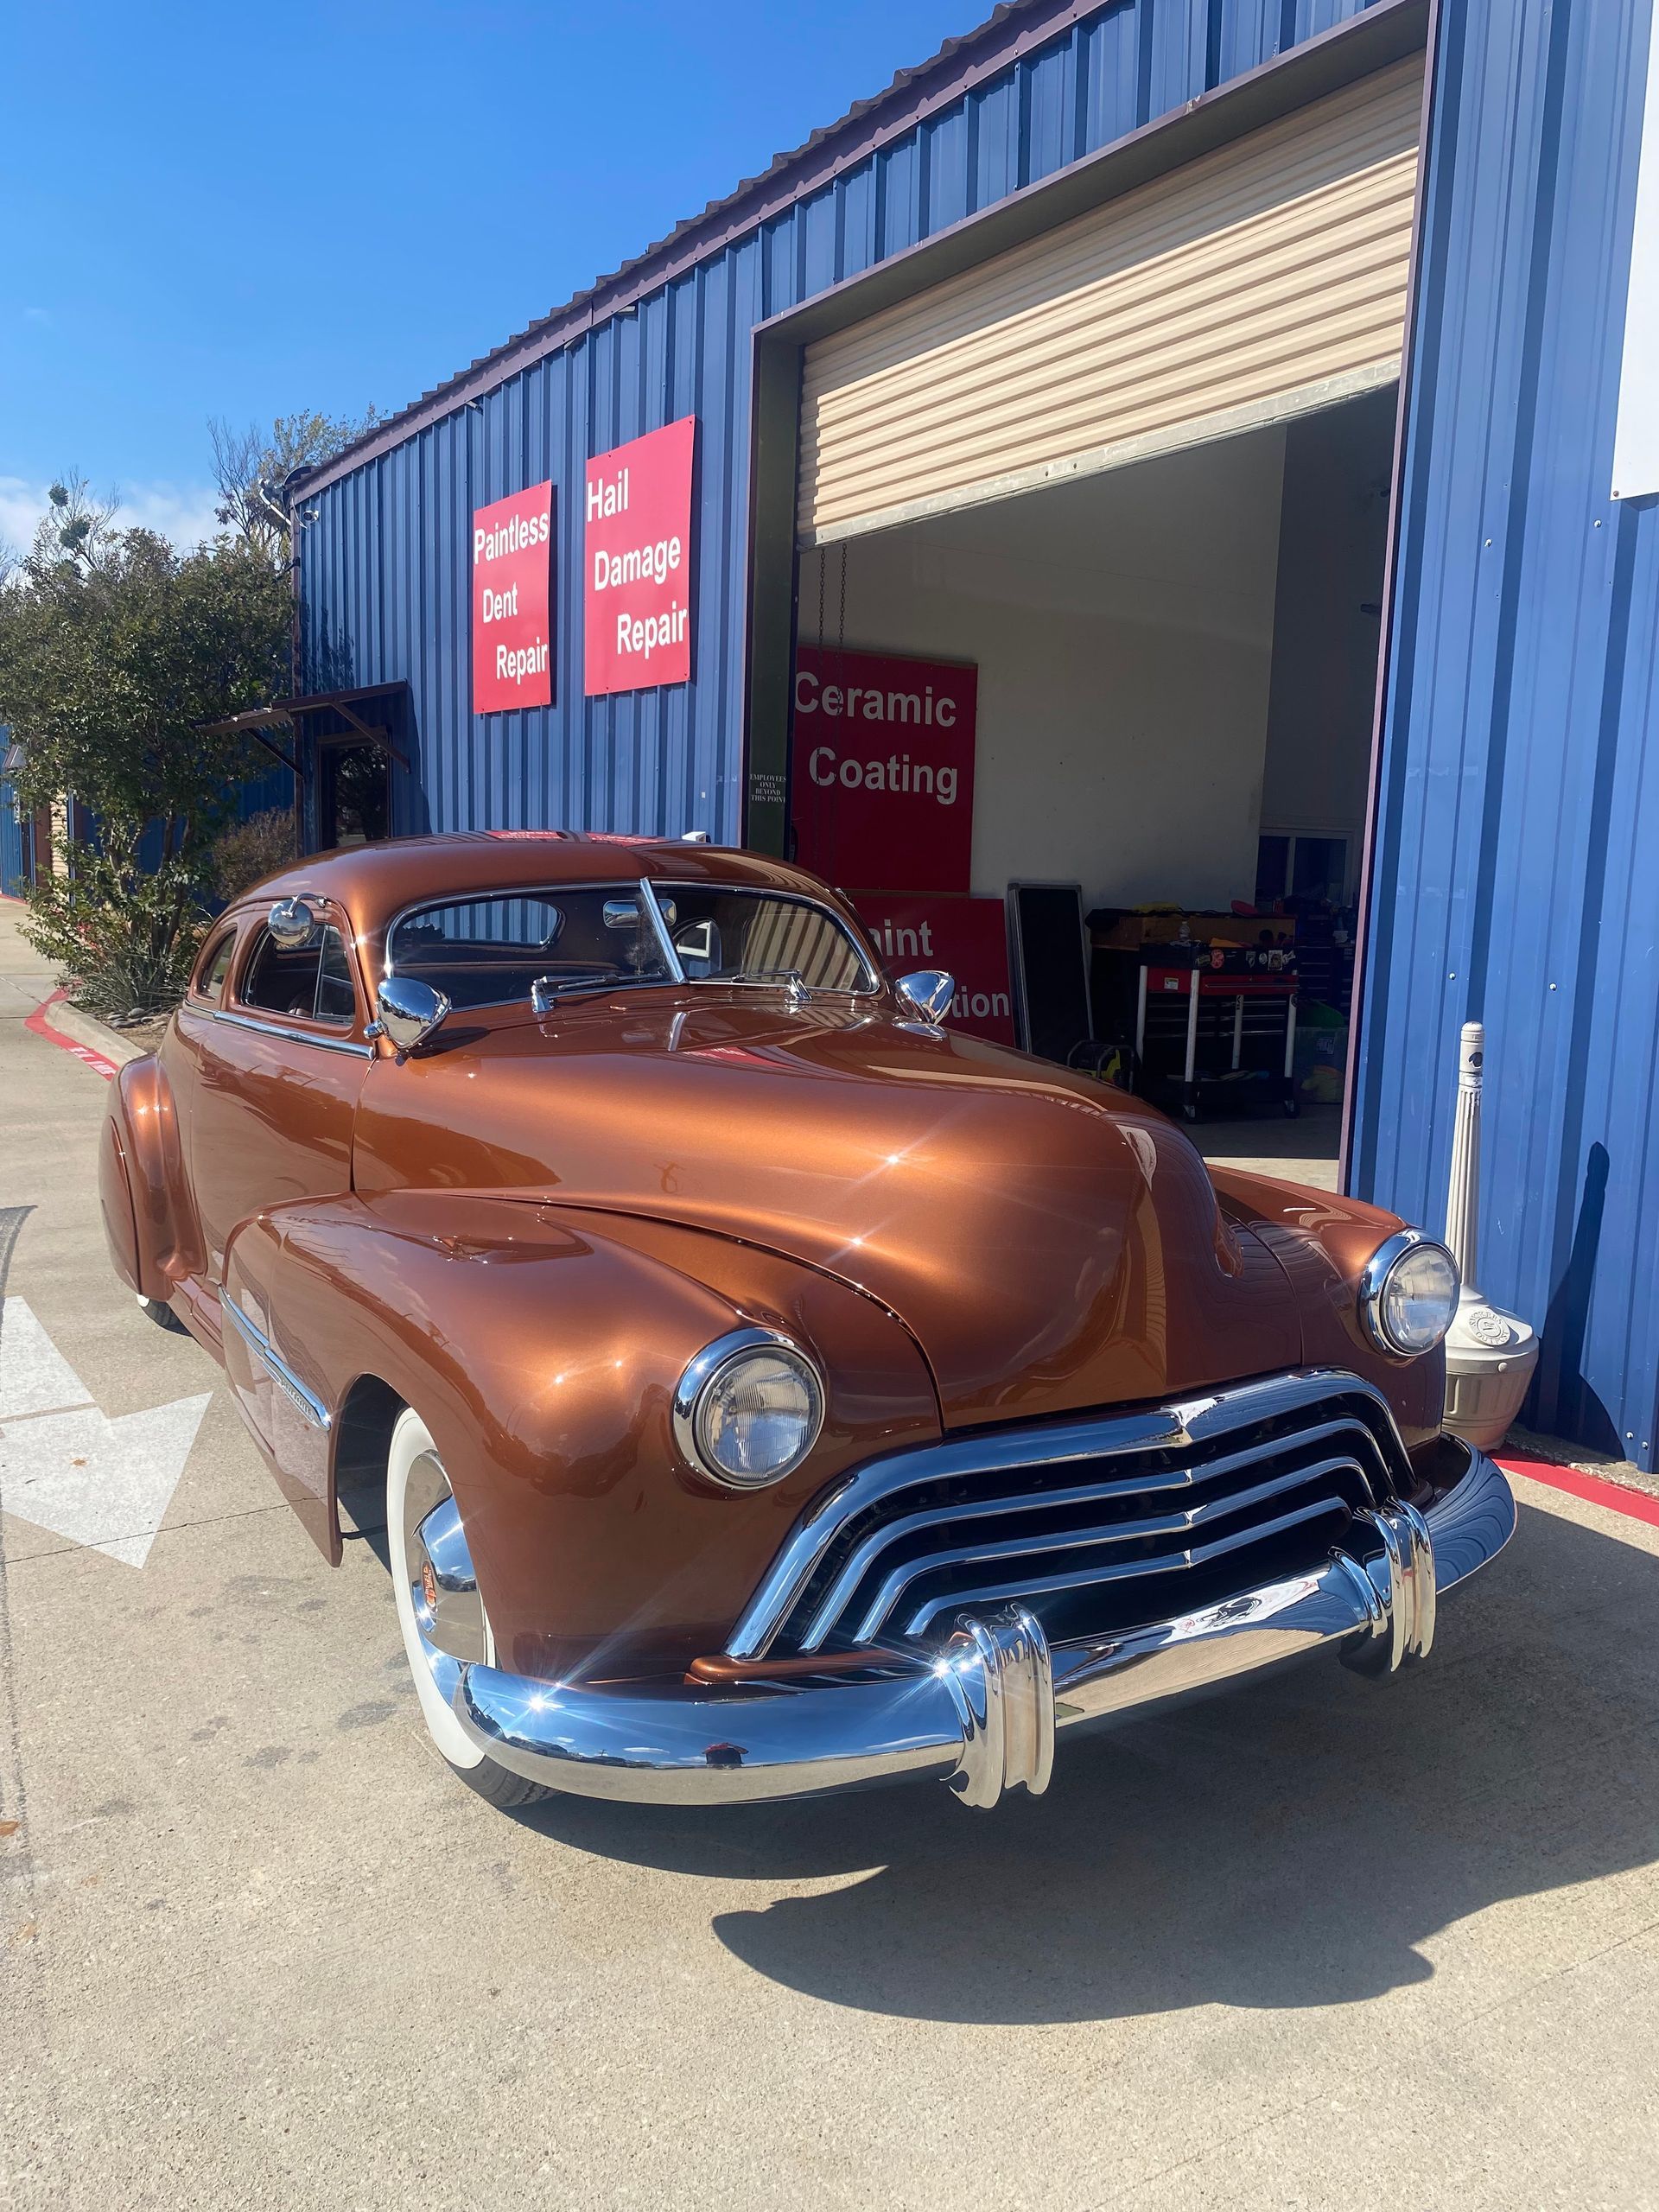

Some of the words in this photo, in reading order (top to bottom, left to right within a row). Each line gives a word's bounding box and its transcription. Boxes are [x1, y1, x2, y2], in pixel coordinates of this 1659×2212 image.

[587, 467, 629, 522] Hail
[474, 512, 549, 564] Paintless
[594, 536, 681, 591] Damage
[483, 582, 518, 623] Dent
[617, 601, 688, 659] Repair
[496, 637, 548, 684] Repair
[795, 671, 957, 727] Ceramic
[750, 773, 786, 782] EMPLOYEES
[809, 747, 957, 804] Coating
